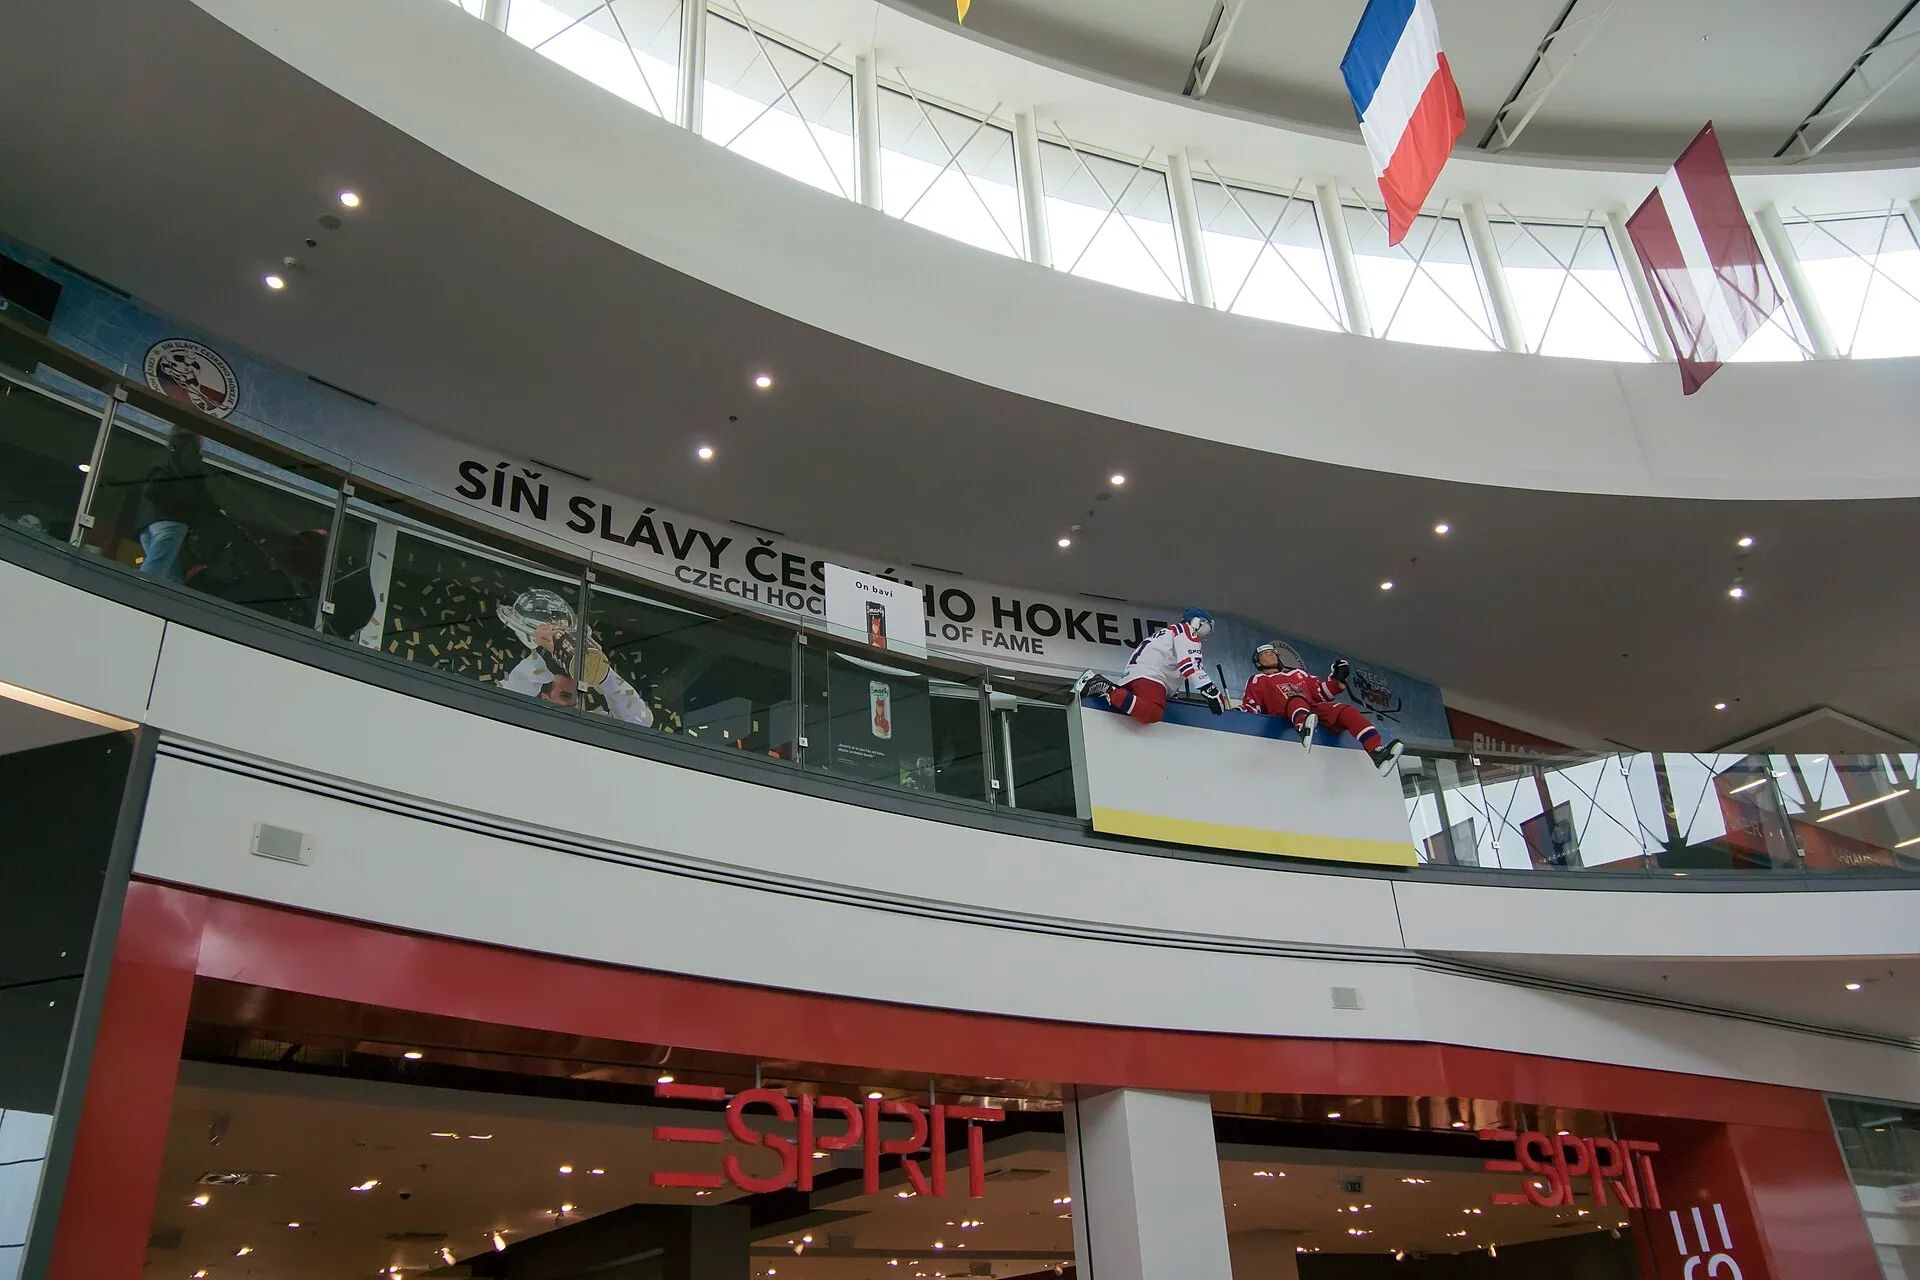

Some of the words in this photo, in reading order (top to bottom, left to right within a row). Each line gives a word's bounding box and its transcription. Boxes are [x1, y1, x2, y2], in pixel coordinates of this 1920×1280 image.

[455, 459, 549, 522] SÍŇ
[566, 496, 733, 569] SLÁVY
[744, 537, 976, 623] ČESHO
[855, 581, 869, 591] On
[674, 564, 759, 601] CZECH
[767, 586, 827, 616] HOC
[941, 623, 974, 644] OF
[981, 630, 1045, 655] FAME
[650, 1083, 1006, 1199] ESPRIT
[1475, 1128, 1661, 1210] ESPRIT
